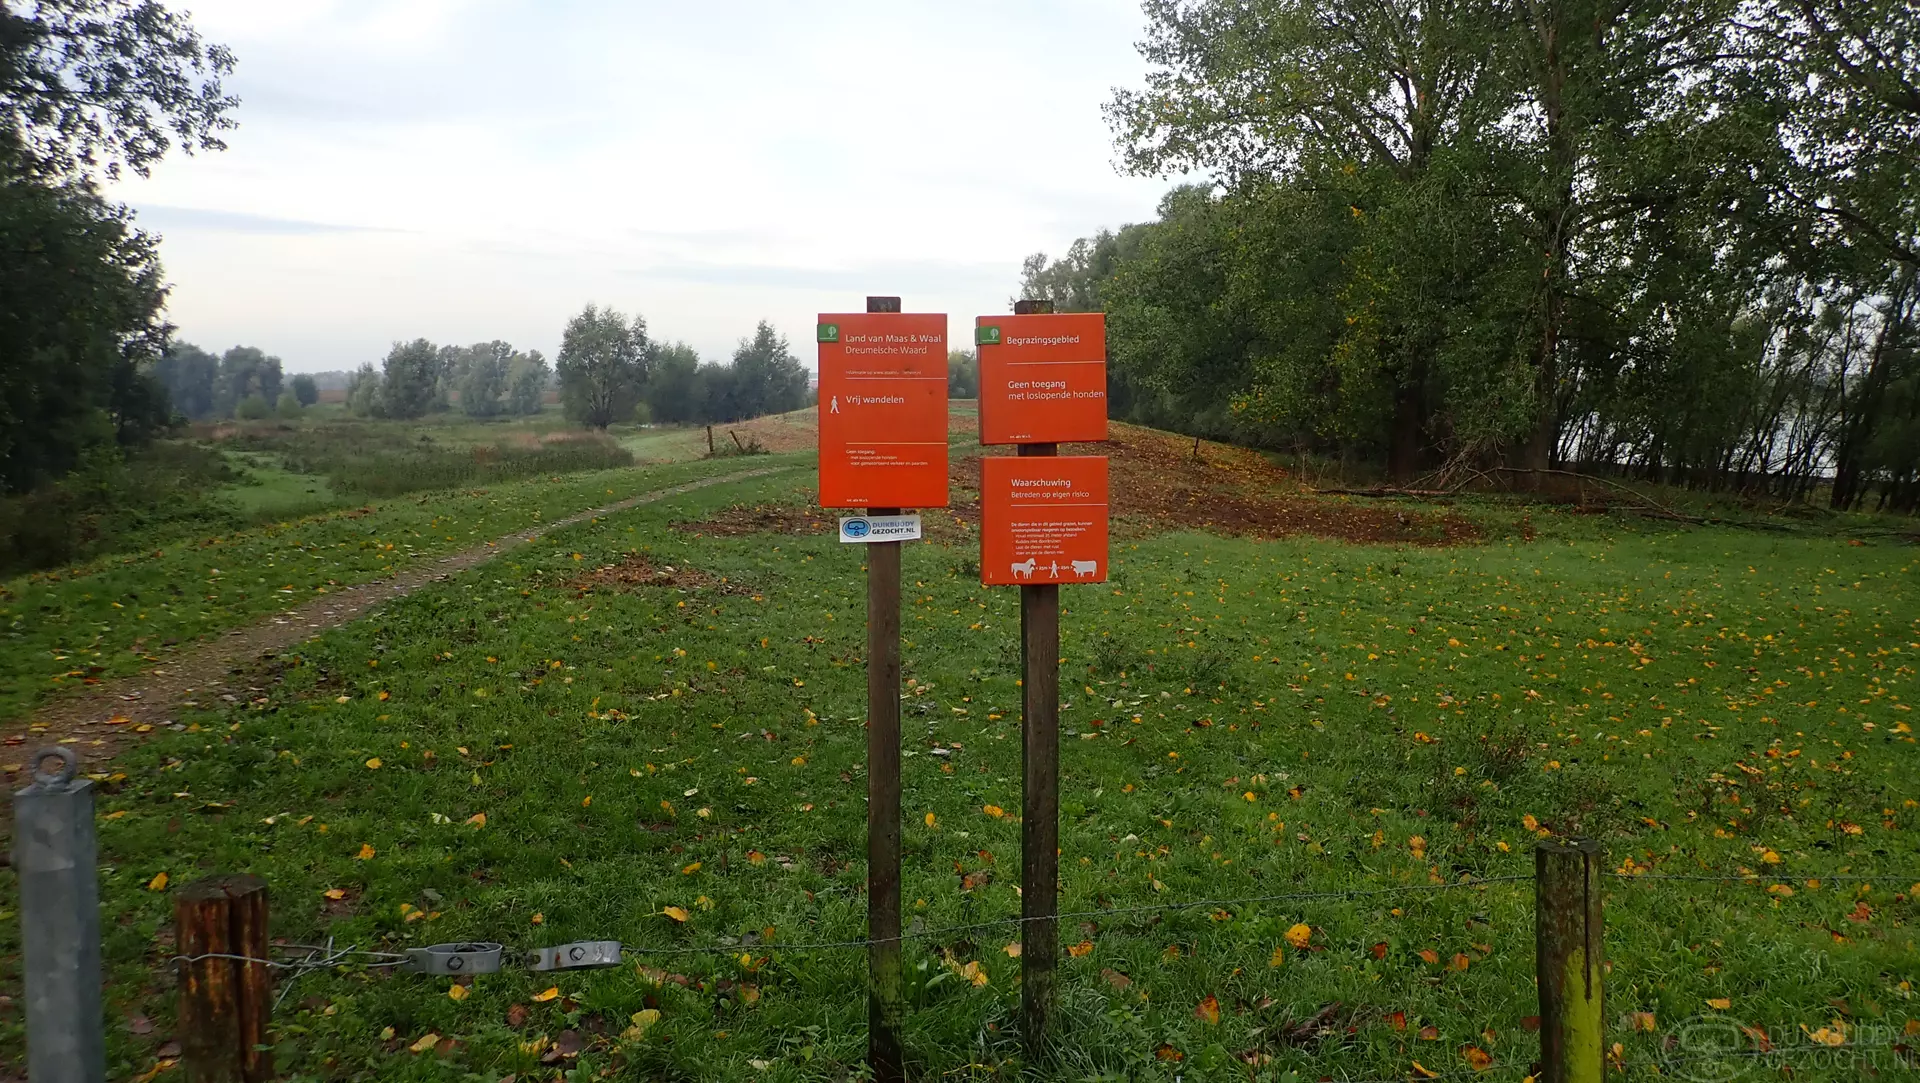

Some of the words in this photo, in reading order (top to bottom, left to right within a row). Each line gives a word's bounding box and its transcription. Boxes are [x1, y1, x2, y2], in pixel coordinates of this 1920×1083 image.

[845, 335, 865, 343] Land
[919, 335, 941, 343] Waal
[1007, 336, 1079, 346] Begrazingsgebied
[845, 346, 898, 354] Dreumelsche
[900, 346, 927, 354] Waard
[1032, 381, 1066, 389] toegang
[1027, 391, 1070, 400] loslopende
[846, 396, 860, 405] Vrij
[1011, 479, 1071, 488] Waarschuwing
